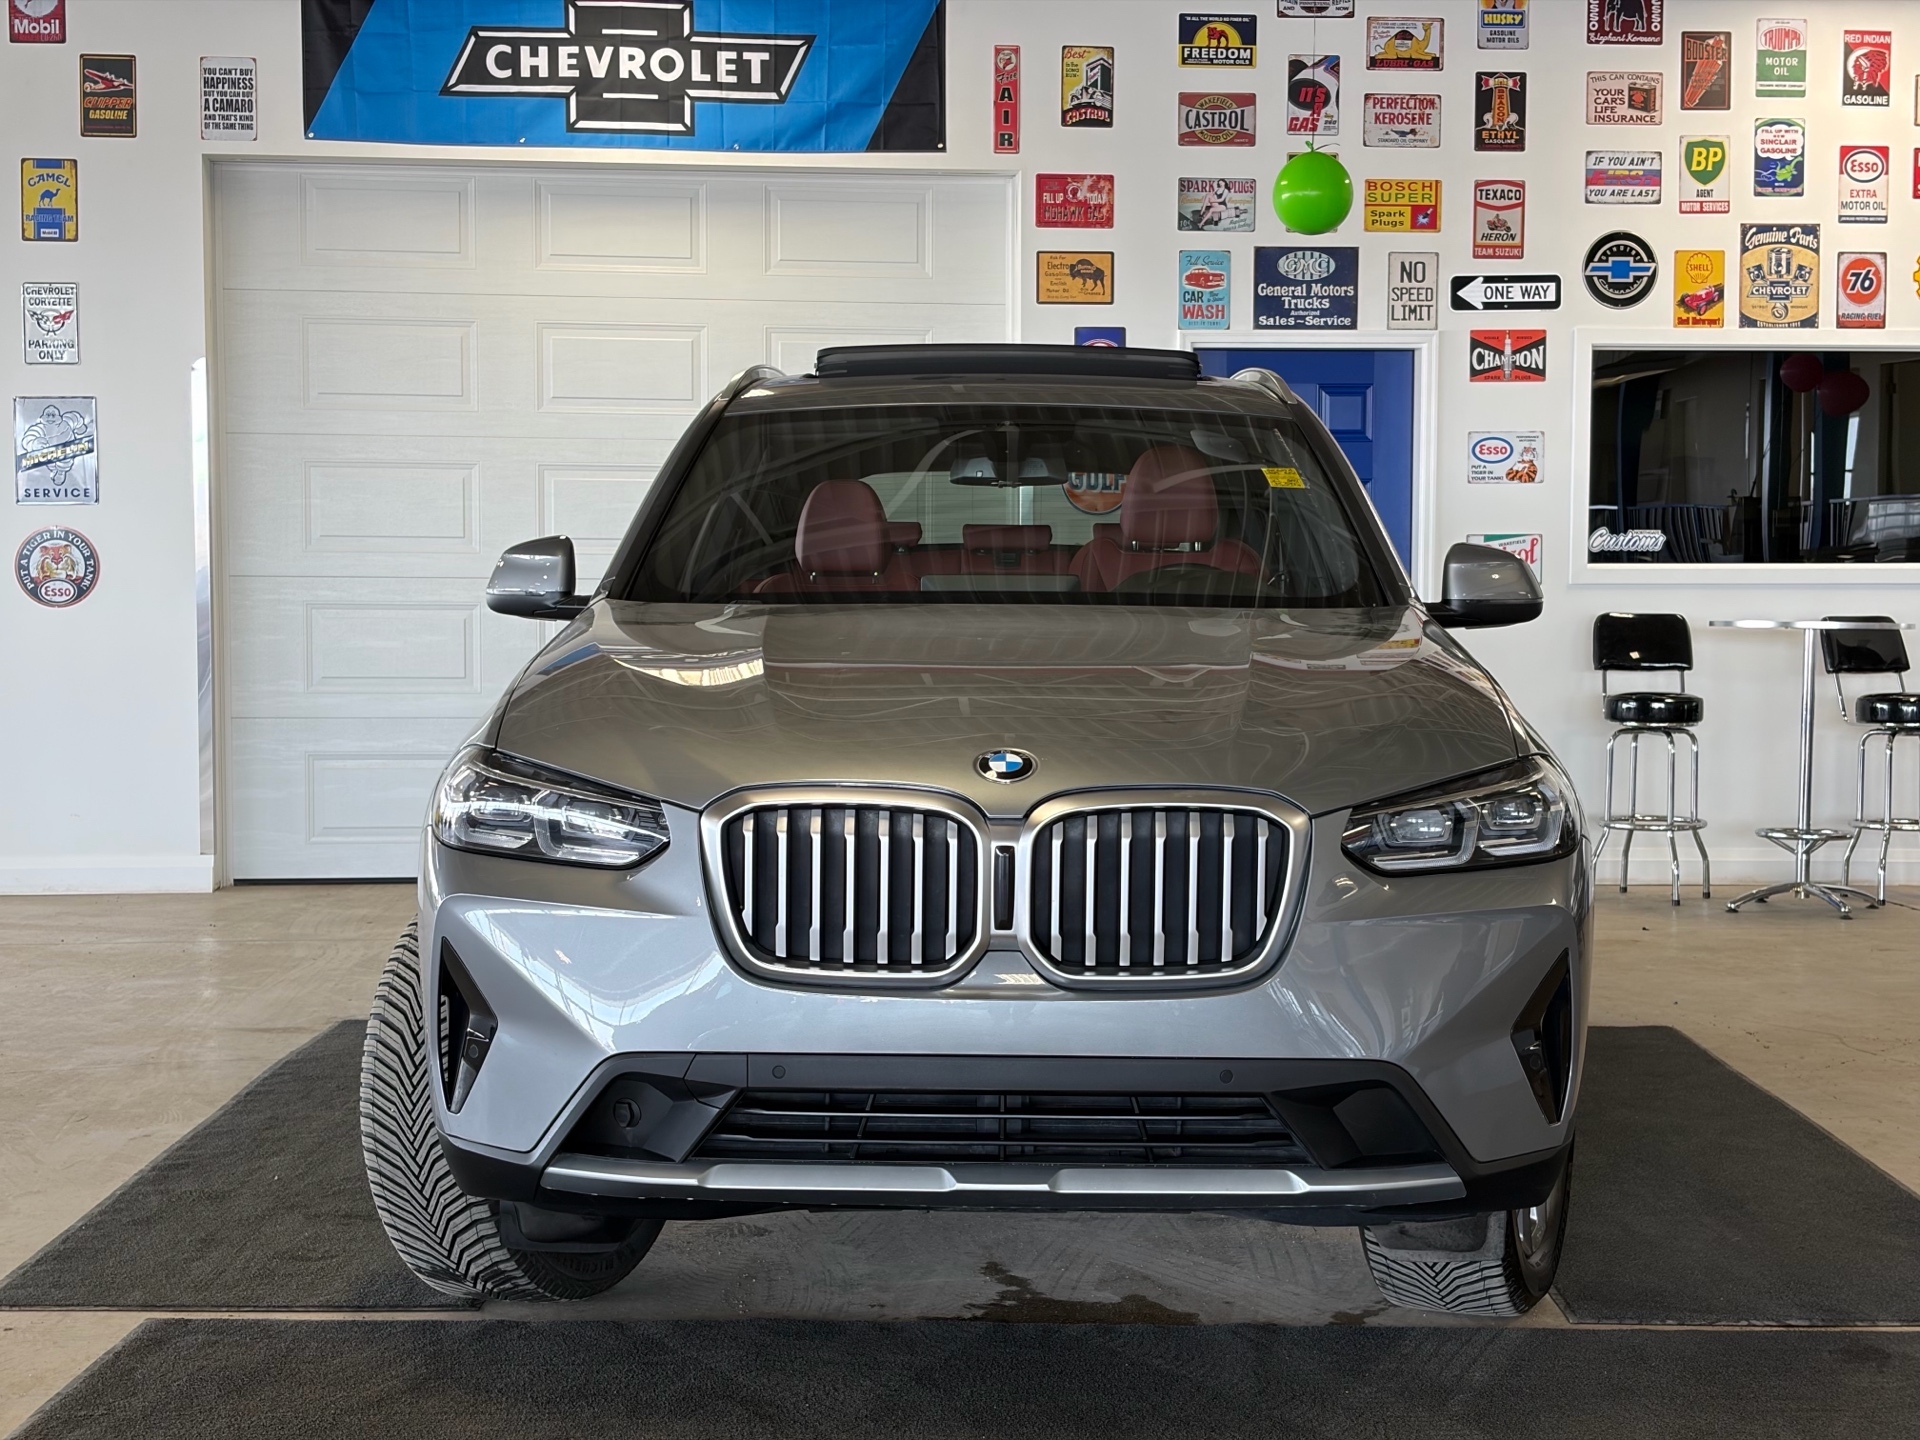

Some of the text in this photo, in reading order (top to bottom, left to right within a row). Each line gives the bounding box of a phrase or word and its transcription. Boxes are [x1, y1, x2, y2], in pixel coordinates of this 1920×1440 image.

[1483, 13, 1522, 25] HUSKY
[14, 19, 59, 34] Mobil
[1589, 32, 1660, 45] Elephant Kerosene
[1763, 27, 1801, 51] TRIUMPH
[1844, 34, 1890, 43] RED INDIAN
[1064, 48, 1086, 59] Best
[1184, 48, 1251, 59] FREEDOM
[1686, 40, 1727, 60] BOOSTER
[485, 43, 771, 84] CHEVROLET
[1765, 57, 1798, 66] MOTOR
[203, 67, 254, 77] YOU CAN'T BUY
[1774, 67, 1789, 76] OIL
[203, 76, 254, 90] HAPPINESS
[995, 72, 1018, 85] Free
[1590, 75, 1607, 83] THIS
[1627, 74, 1660, 84] CONTAINS
[216, 90, 228, 98] YOU
[229, 90, 240, 98] CAN
[1593, 88, 1625, 96] YOUR
[84, 96, 133, 109] CLIPPER
[203, 98, 254, 113] A CAMARO
[1198, 97, 1233, 109] WAKEFIELD
[1372, 97, 1435, 110] PERFECTION
[1594, 97, 1625, 105] CAR'S
[1843, 95, 1888, 105] GASOLINE
[1497, 89, 1505, 123] BEACON
[1594, 106, 1617, 114] LIFE
[89, 110, 128, 120] GASOLINE
[204, 113, 217, 121] AND
[218, 114, 238, 122] THAT'S
[998, 87, 1014, 148] AIR
[1065, 108, 1110, 125] CASTROL
[1185, 109, 1249, 131] CASTROL
[1374, 112, 1432, 125] KEROSENE
[1594, 115, 1656, 123] INSURANCE
[204, 122, 254, 131] OF THE SAME THING
[1288, 117, 1319, 132] GAS
[1198, 130, 1234, 142] MOTOR OIL
[1482, 131, 1519, 139] ETHYL
[1593, 157, 1656, 166] IF YOU AIN'T
[1691, 147, 1722, 171] BP
[28, 173, 71, 188] CAMEL
[1180, 180, 1254, 193] SPARK PLUGS
[1367, 181, 1433, 192] BOSCH
[1043, 193, 1106, 204] FILL UP TODAY
[1367, 192, 1433, 203] SUPER
[1478, 189, 1522, 200] TEXACO
[1589, 189, 1656, 197] YOU ARE LAST
[1696, 189, 1714, 198] AGENT
[1849, 189, 1877, 198] EXTRA
[1681, 202, 1728, 212] MOTOR SERVICES
[1840, 201, 1886, 210] MOTOR OIL
[25, 214, 74, 222] RACING TEAM
[1044, 206, 1106, 221] MOHAWK GAS
[1370, 210, 1405, 218] Spark
[1371, 219, 1404, 228] Plugs
[1481, 233, 1517, 241] HERON
[1745, 227, 1817, 249] Genuine Parts
[1475, 248, 1522, 257] TEAM SUZUKI
[1047, 262, 1070, 270] Electro
[1185, 255, 1224, 266] Full Service
[1284, 257, 1329, 275] GMC
[1400, 261, 1426, 283] NO
[1847, 267, 1876, 294] 76
[25, 287, 75, 296] CHEVROLET
[1257, 283, 1354, 296] General Motors
[1391, 287, 1433, 302] SPEED
[1484, 285, 1550, 300] ONE WAY
[1753, 287, 1807, 295] CHEVROLET
[28, 298, 72, 306] CORVETTE
[1183, 291, 1204, 303] CAR
[1281, 297, 1330, 308] Trucks
[1182, 304, 1225, 319] WASH
[1391, 305, 1433, 321] LIMIT
[28, 340, 75, 349] PARKING
[38, 350, 66, 361] ONLY
[1472, 345, 1545, 370] CHAMPION
[21, 440, 89, 468] MICHELIN
[1068, 472, 1126, 493] GULF
[24, 488, 90, 498] SERVICE
[53, 529, 65, 539] IN
[23, 531, 51, 558] TIGER
[67, 533, 91, 557] YOUR
[1498, 539, 1526, 547] WAKEFIELD
[1589, 527, 1666, 553] Customs
[20, 558, 28, 567] A
[20, 569, 35, 590] PUT
